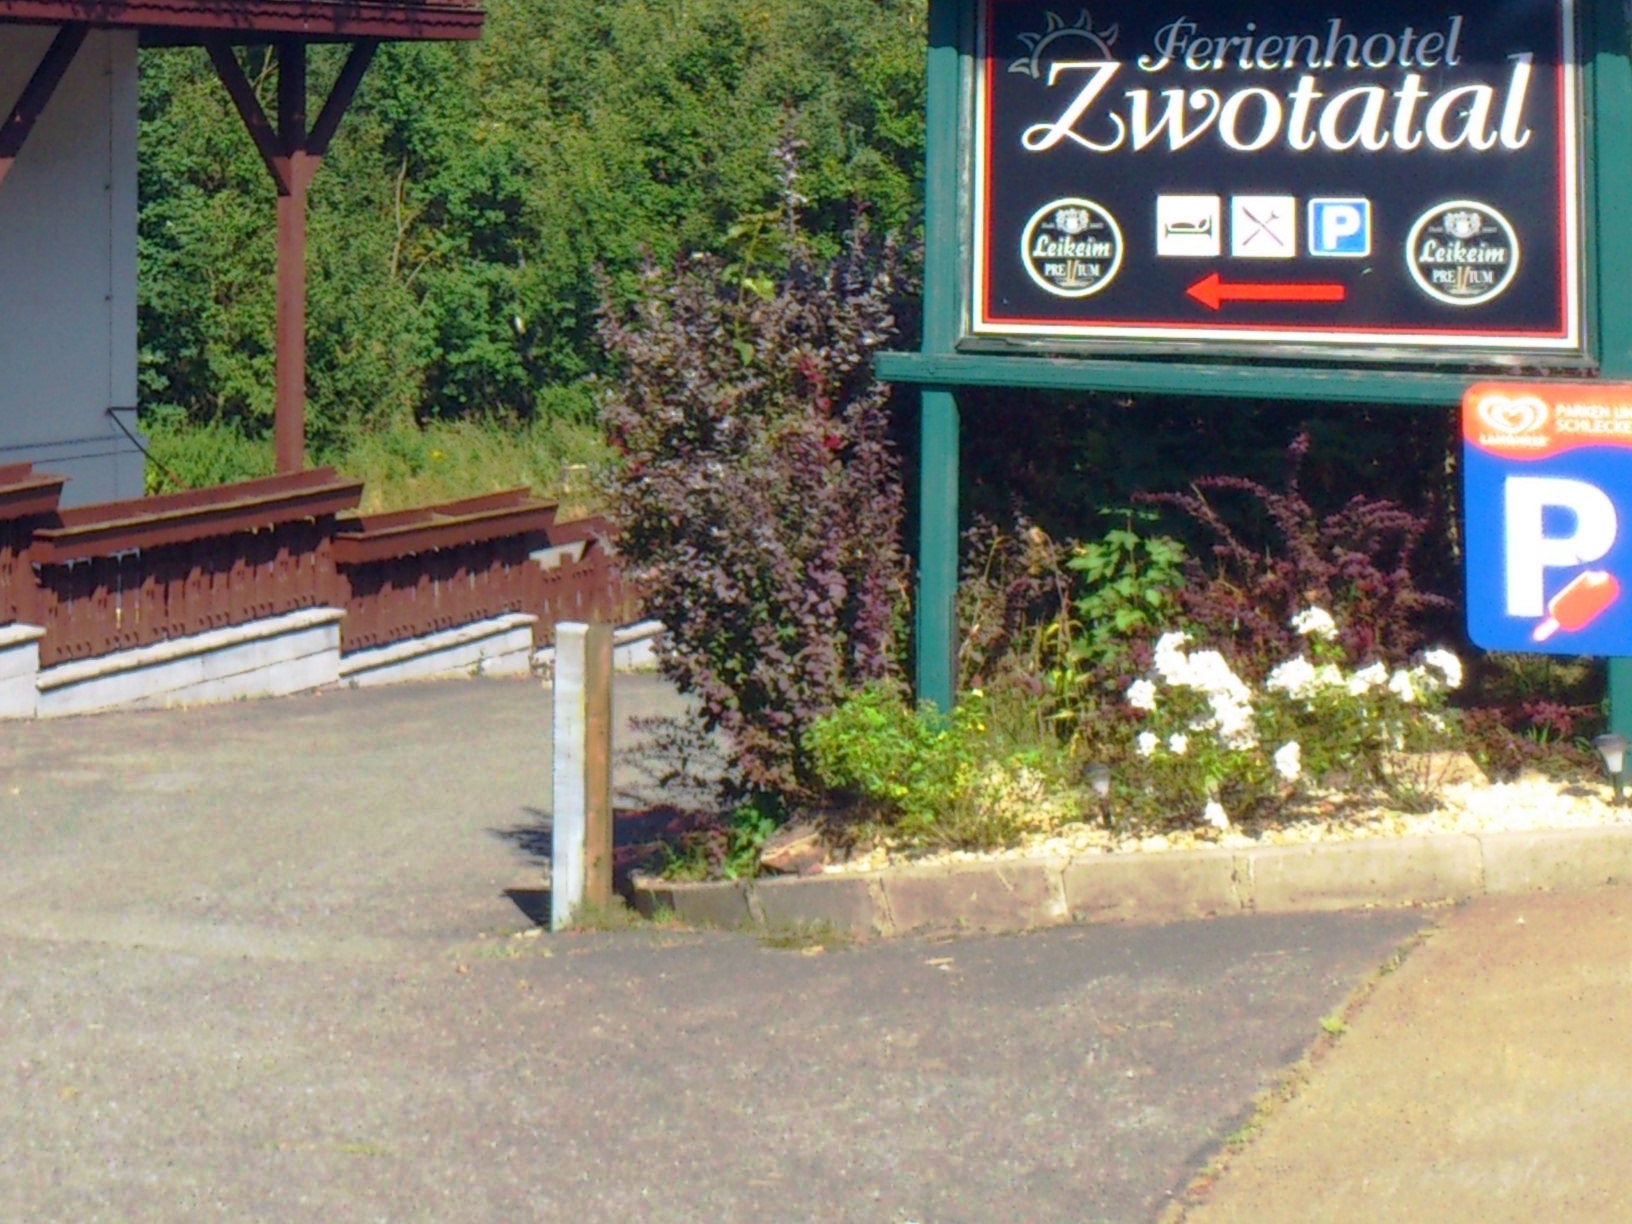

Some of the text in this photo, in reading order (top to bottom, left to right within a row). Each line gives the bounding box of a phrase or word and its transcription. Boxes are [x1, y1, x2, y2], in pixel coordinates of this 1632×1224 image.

[1138, 15, 1462, 72] Ferienhotel
[1021, 52, 1534, 152] Zwotatal
[1032, 234, 1111, 257] Leikeim
[1322, 205, 1361, 250] P
[1418, 239, 1505, 263] Leikeim
[1555, 403, 1610, 417] PARKEN
[1504, 475, 1618, 618] P
